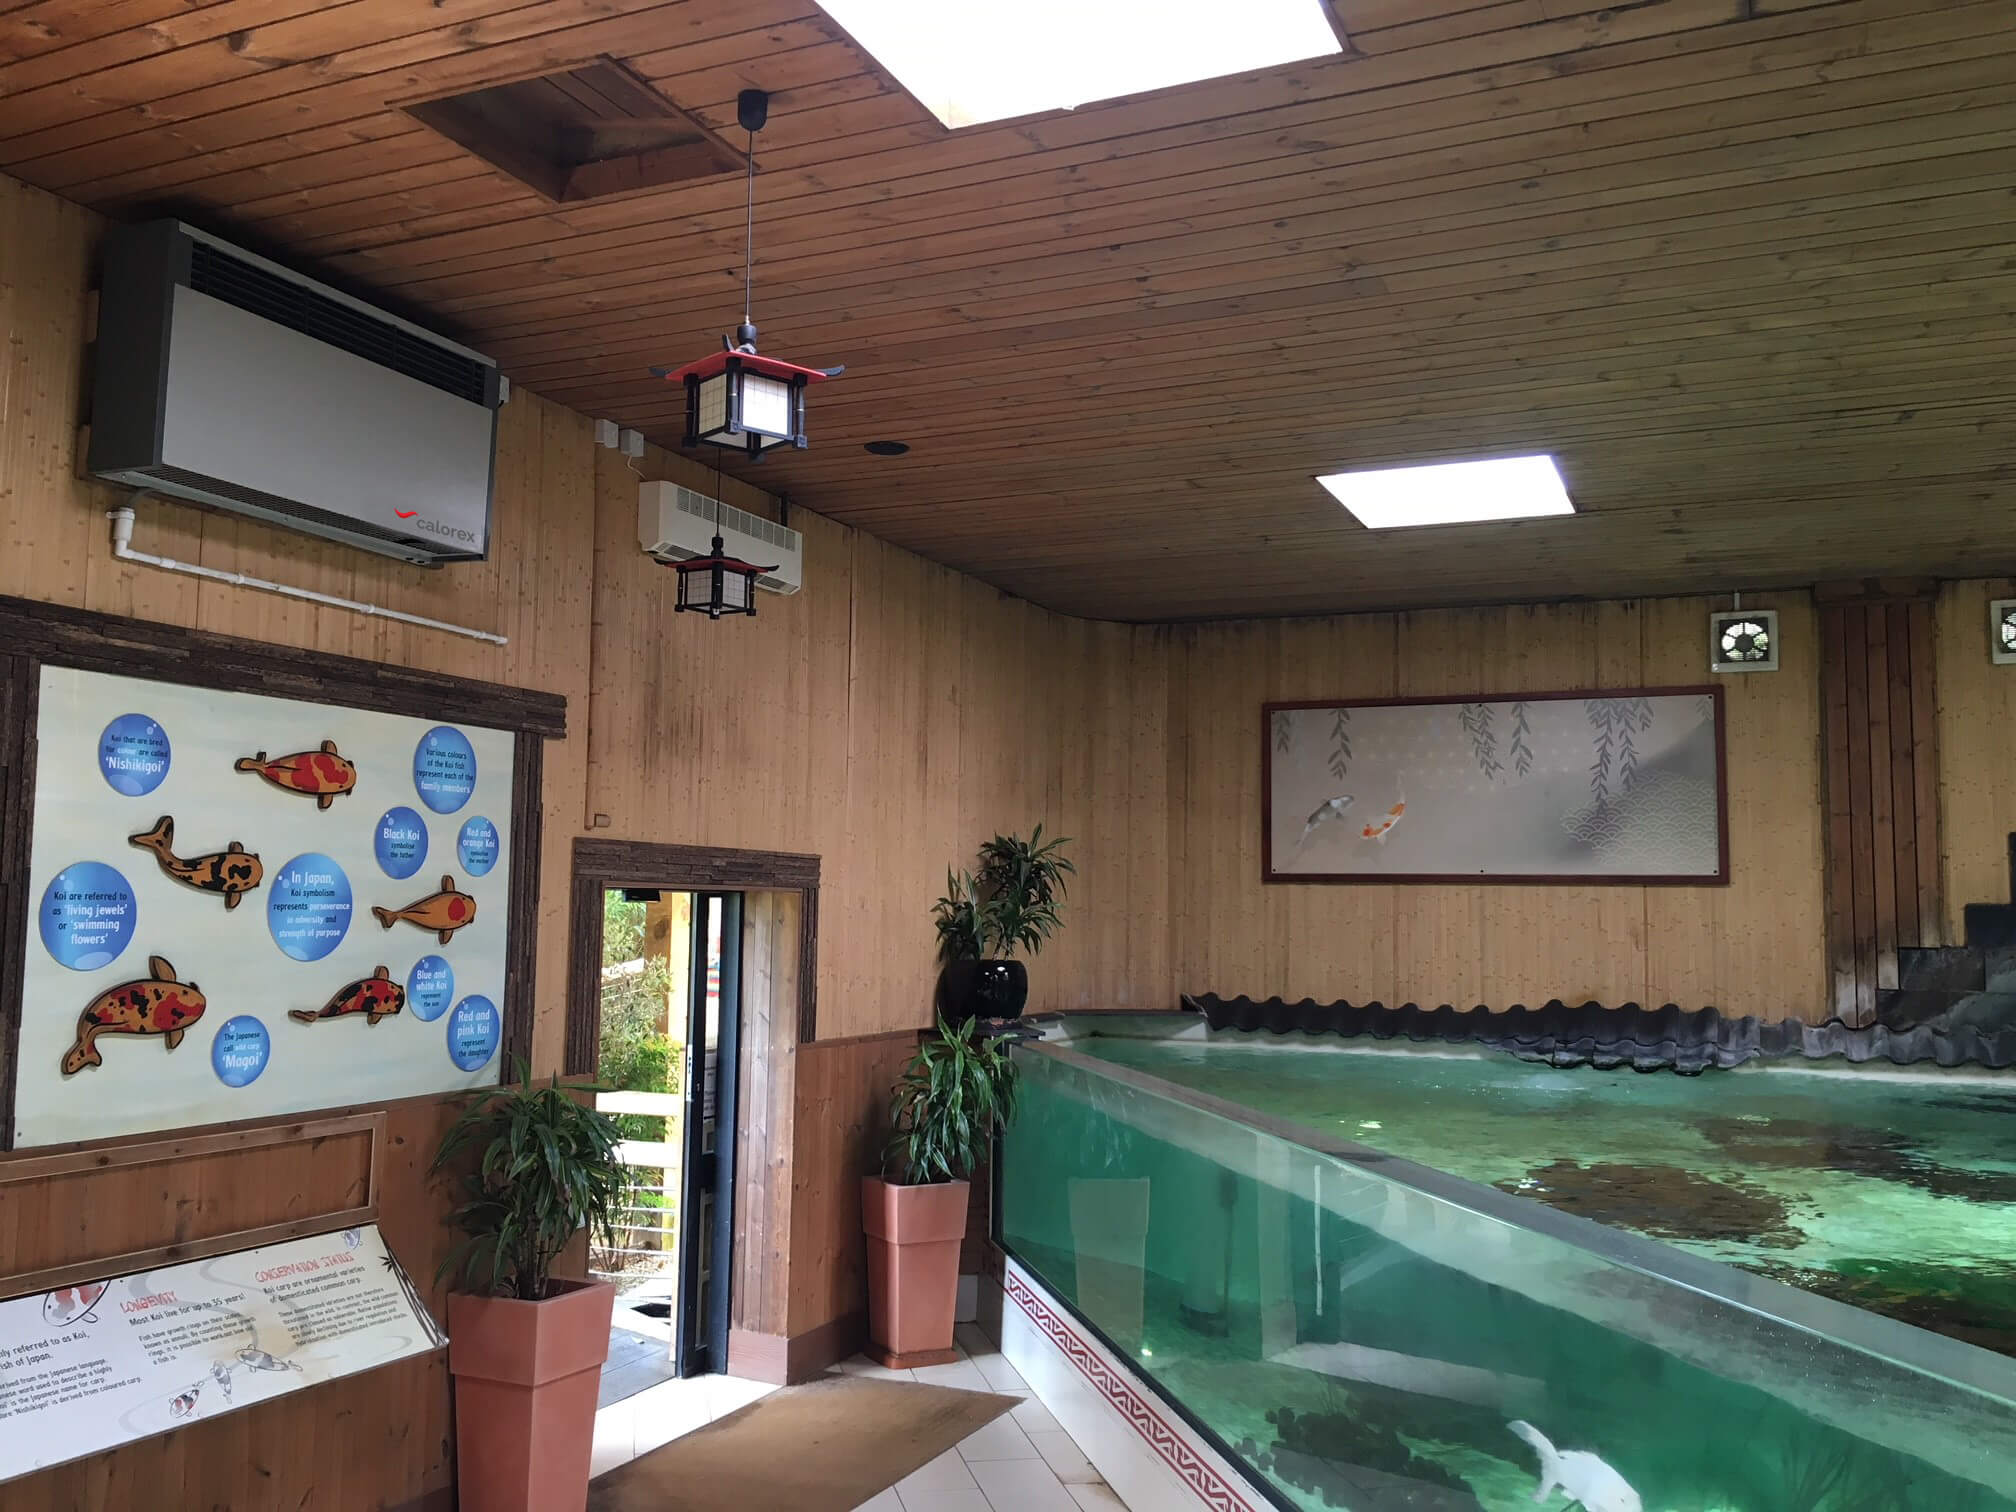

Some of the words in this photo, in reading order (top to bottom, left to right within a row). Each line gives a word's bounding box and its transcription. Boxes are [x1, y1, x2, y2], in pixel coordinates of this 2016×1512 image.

[416, 519, 475, 542] calorex
[123, 736, 136, 744] that
[426, 749, 446, 757] Various
[447, 752, 467, 760] colours
[435, 760, 444, 768] the
[416, 770, 443, 778] represent
[444, 772, 457, 780] each
[383, 827, 405, 839] Black
[407, 829, 421, 841] Koi
[466, 827, 479, 837] Red
[480, 829, 491, 838] and
[462, 839, 483, 849] orange
[485, 839, 496, 849] Koi
[291, 870, 301, 884] In
[304, 871, 335, 887] Japan,
[54, 891, 67, 901] Koi
[69, 893, 82, 901] are
[84, 891, 117, 901] referred
[119, 891, 128, 901] to
[291, 888, 302, 897] Koi
[303, 888, 336, 899] symbolism
[52, 908, 62, 916] as
[94, 903, 128, 918] jewels'
[273, 902, 308, 912] represents
[309, 903, 350, 912] perseverance
[325, 915, 337, 923] and
[58, 922, 68, 931] or
[278, 929, 306, 939] strength
[307, 928, 315, 937] of
[315, 929, 341, 939] purpose
[416, 969, 432, 980] Blue
[433, 970, 446, 980] and
[416, 981, 434, 992] white
[435, 981, 448, 991] Koi
[458, 1010, 474, 1022] Red
[475, 1009, 490, 1021] and
[224, 1033, 234, 1041] The
[235, 1032, 261, 1042] Japanese
[457, 1024, 474, 1040] pink
[477, 1022, 490, 1035] Koi
[461, 1039, 486, 1049] represent
[222, 1051, 263, 1071] 'Magoi'
[255, 1259, 320, 1283] CONSERVATION
[320, 1251, 354, 1268] STATUS
[275, 1281, 291, 1292] carp
[291, 1280, 303, 1288] are
[303, 1270, 338, 1285] ornamental
[119, 1290, 178, 1313] LONGEVITY
[128, 1316, 150, 1326] Most
[150, 1312, 164, 1321] Koi
[164, 1309, 178, 1318] live
[178, 1305, 191, 1314] for
[191, 1303, 202, 1312] up
[211, 1296, 223, 1306] 35
[12, 1339, 49, 1355] referred
[50, 1337, 61, 1346] to
[61, 1335, 72, 1343] as
[72, 1329, 90, 1341] Koi,
[15, 1357, 25, 1367] of
[26, 1352, 54, 1367] Japan.
[18, 1384, 34, 1394] word
[35, 1381, 51, 1391] used
[60, 1371, 88, 1383] describe
[93, 1366, 113, 1375] highly
[20, 1376, 37, 1385] from
[49, 1366, 77, 1378] Japanese
[31, 1389, 60, 1403] Japanese
[60, 1384, 78, 1392] name
[78, 1380, 88, 1388] for
[59, 1391, 83, 1403] derived
[83, 1388, 99, 1396] from
[100, 1379, 126, 1392] coloured
